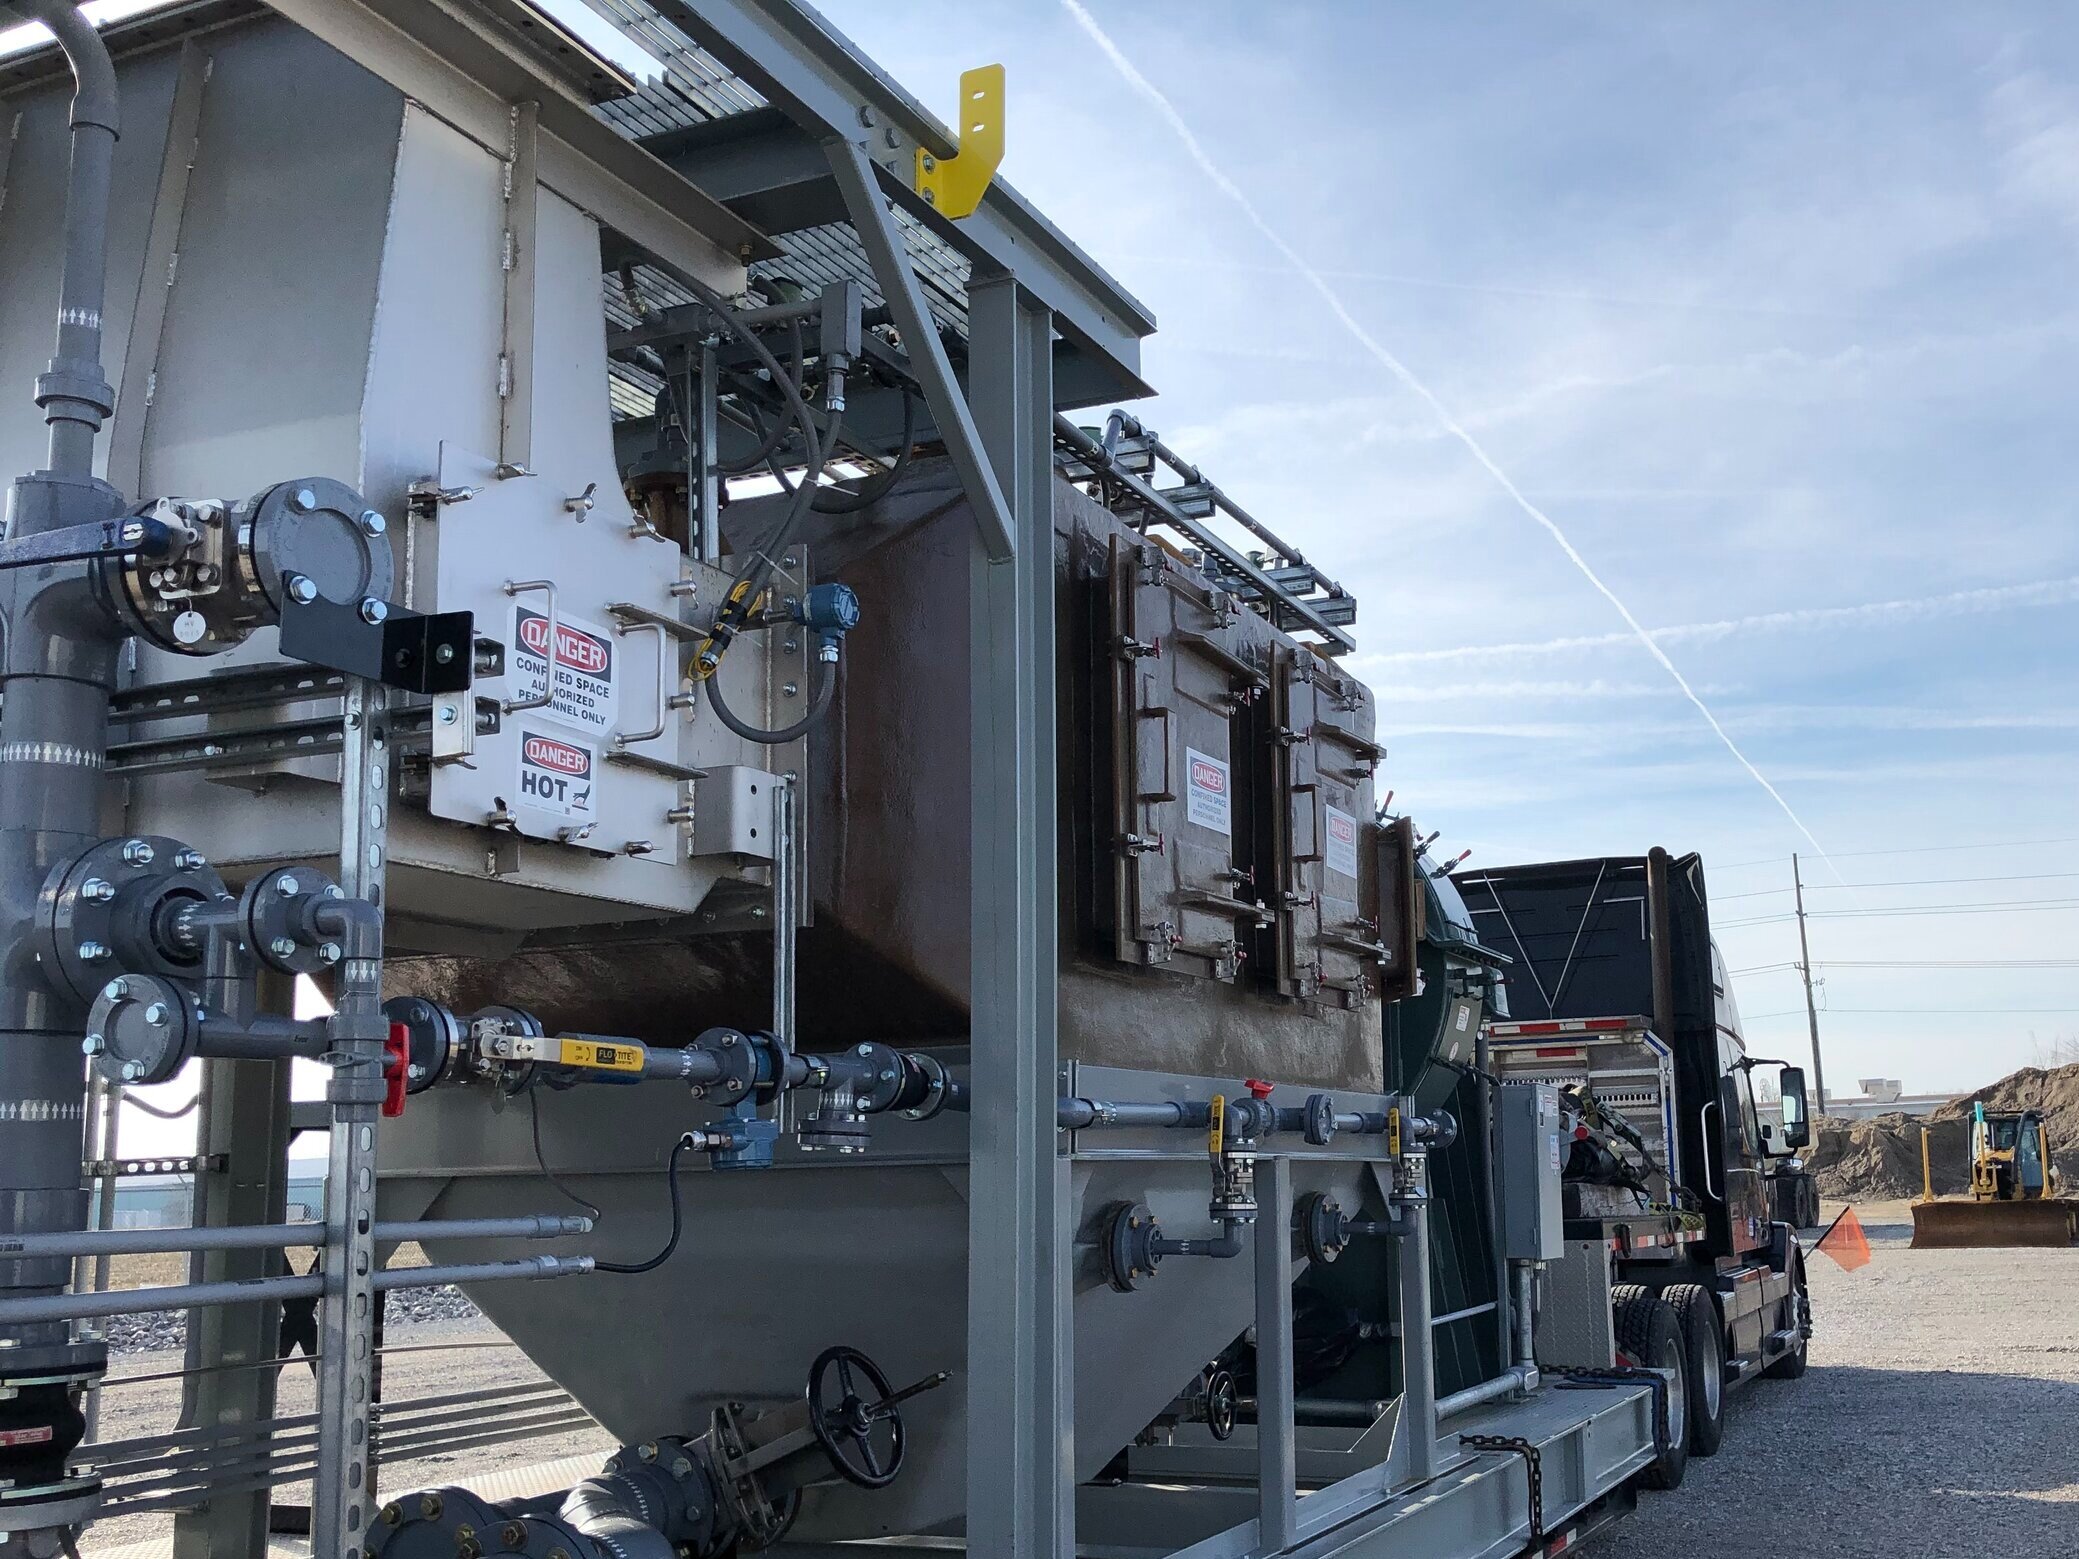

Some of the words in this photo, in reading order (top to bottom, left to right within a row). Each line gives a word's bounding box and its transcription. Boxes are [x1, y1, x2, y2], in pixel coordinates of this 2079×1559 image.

[527, 622, 602, 669] DANGER
[531, 679, 595, 708] AUHORIZED
[576, 677, 610, 698] SPACE
[581, 710, 606, 725] ONLY
[530, 741, 584, 771] DANGER
[521, 769, 568, 802] HOT
[1194, 764, 1223, 789] DANGER
[598, 1049, 613, 1059] FLO
